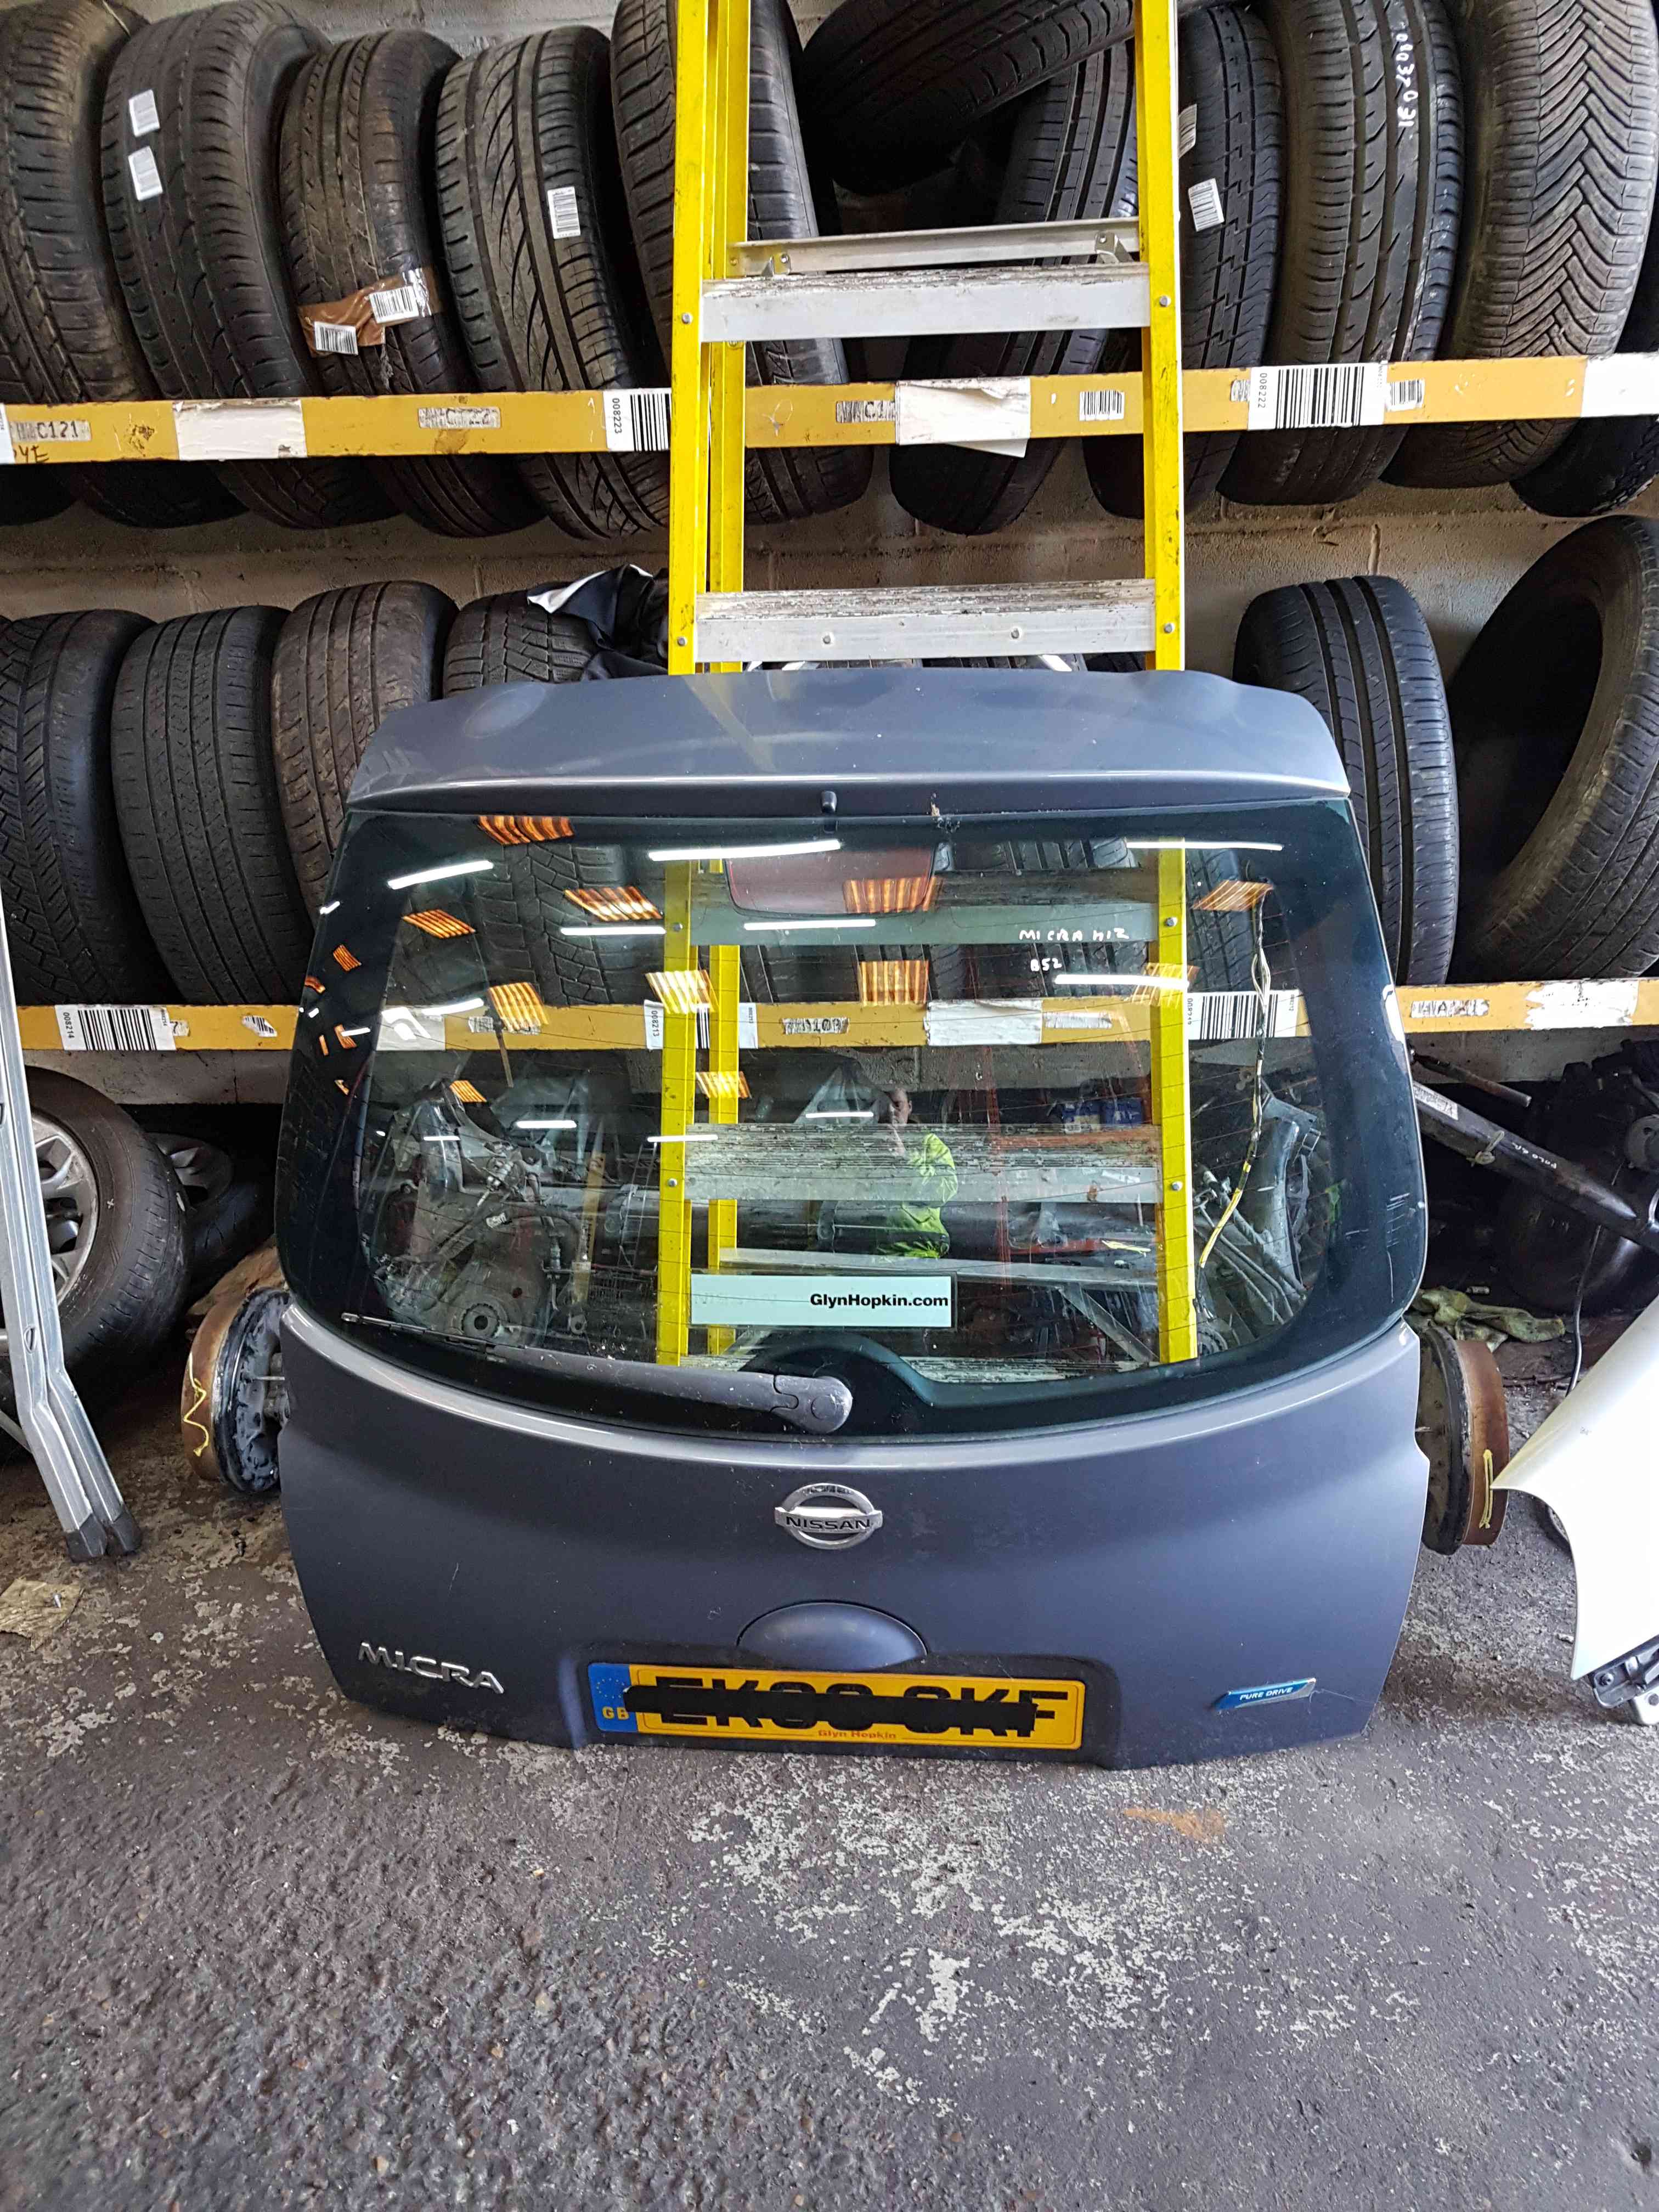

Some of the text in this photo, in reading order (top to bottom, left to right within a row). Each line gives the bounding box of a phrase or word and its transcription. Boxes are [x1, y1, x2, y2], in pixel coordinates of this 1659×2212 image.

[1257, 373, 1268, 409] 008222
[612, 397, 623, 435] 008223
[37, 421, 78, 439] C121
[63, 1012, 75, 1039] 008214
[651, 1010, 660, 1037] 008213
[810, 1294, 948, 1309] GlynHopkin.com
[786, 1516, 870, 1530] NISSAN
[358, 1642, 504, 1694] MICRA
[1240, 1687, 1294, 1700] PURE DRIVE
[602, 1706, 629, 1720] GB
[819, 1729, 896, 1739] Glyn Hopkin
